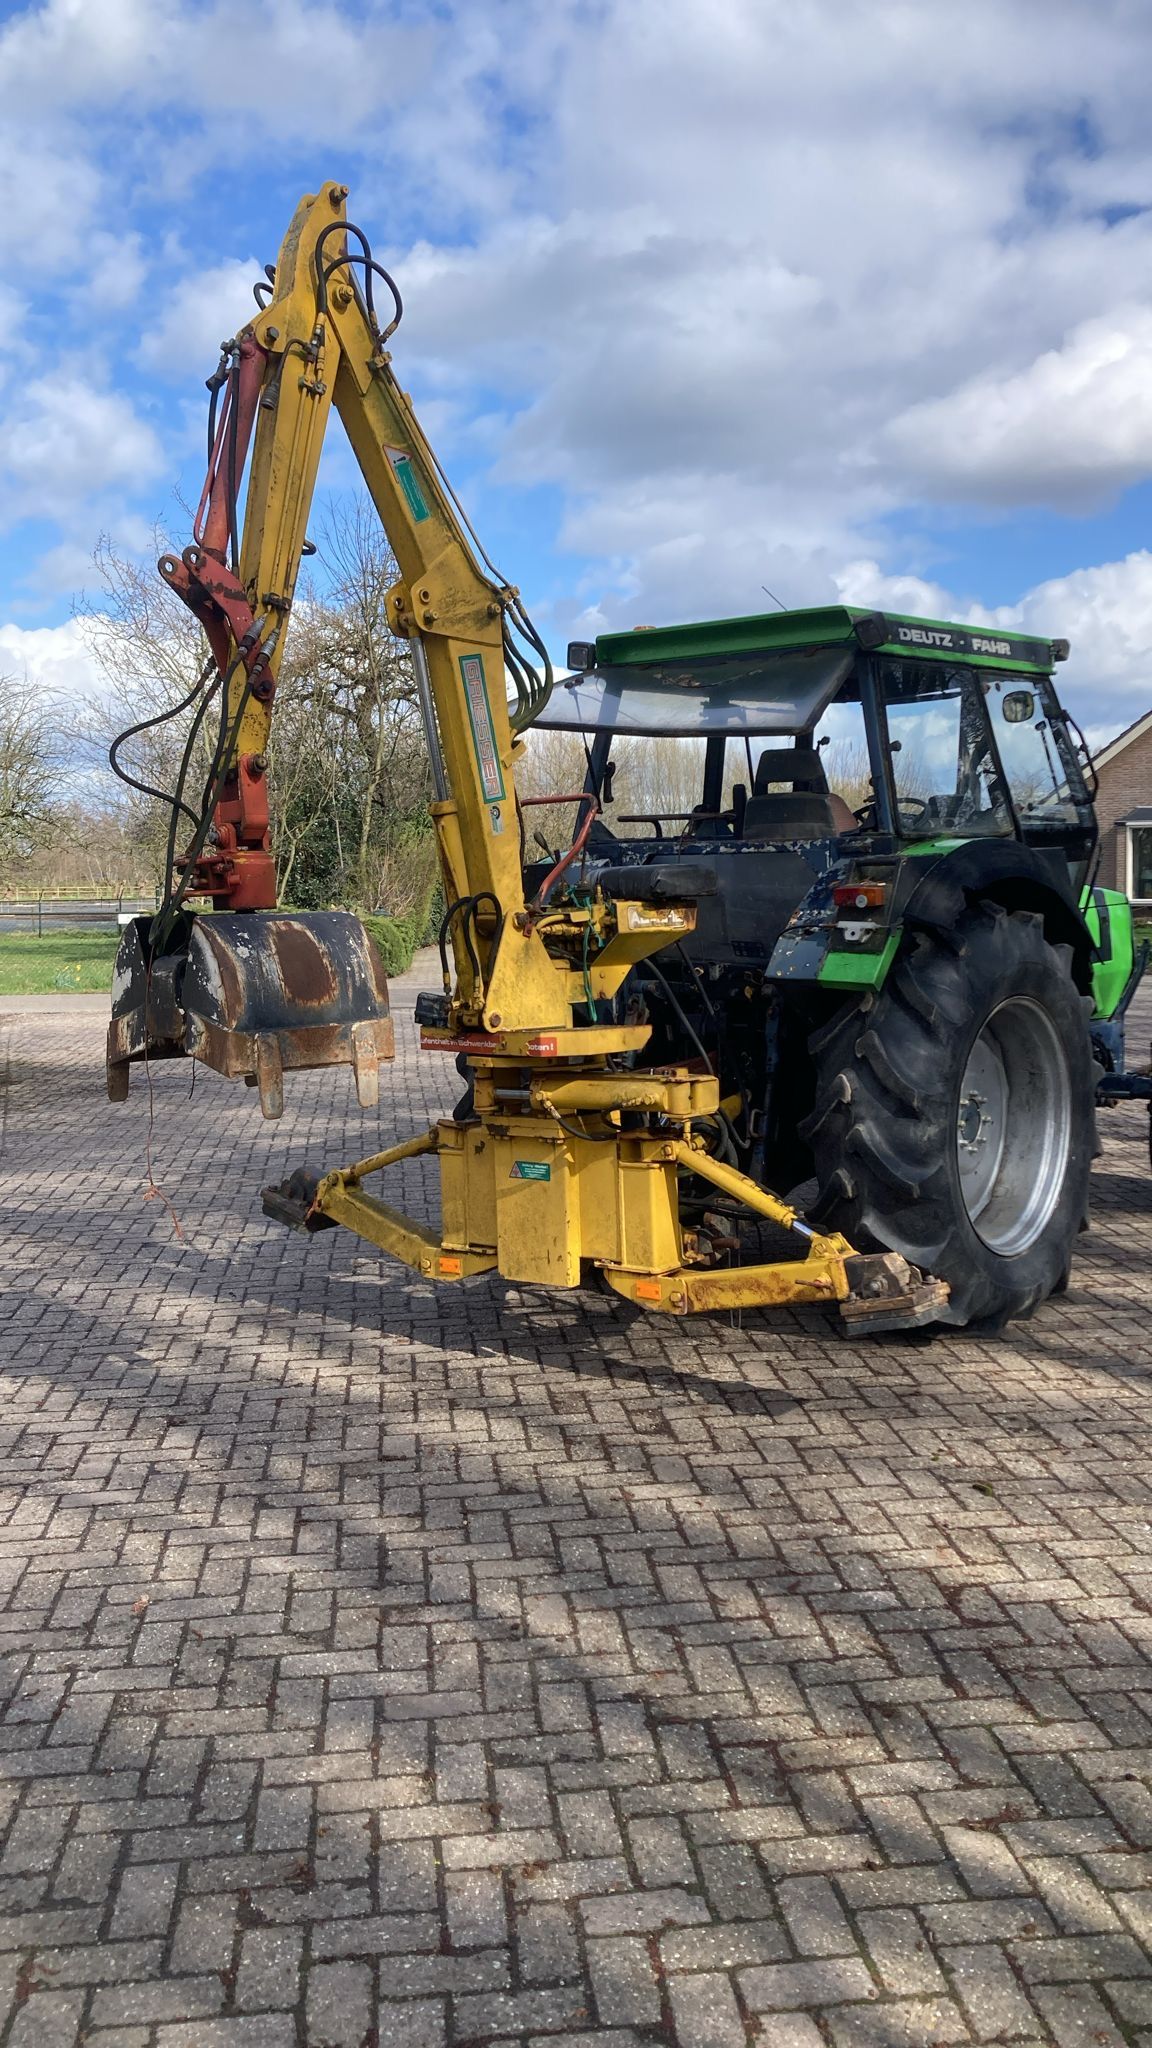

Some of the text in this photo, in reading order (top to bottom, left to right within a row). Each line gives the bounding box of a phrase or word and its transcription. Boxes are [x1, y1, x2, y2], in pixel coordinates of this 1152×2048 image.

[898, 627, 953, 648] DEUTZ
[972, 638, 1012, 656] FAHR
[465, 661, 500, 796] GRIESSER
